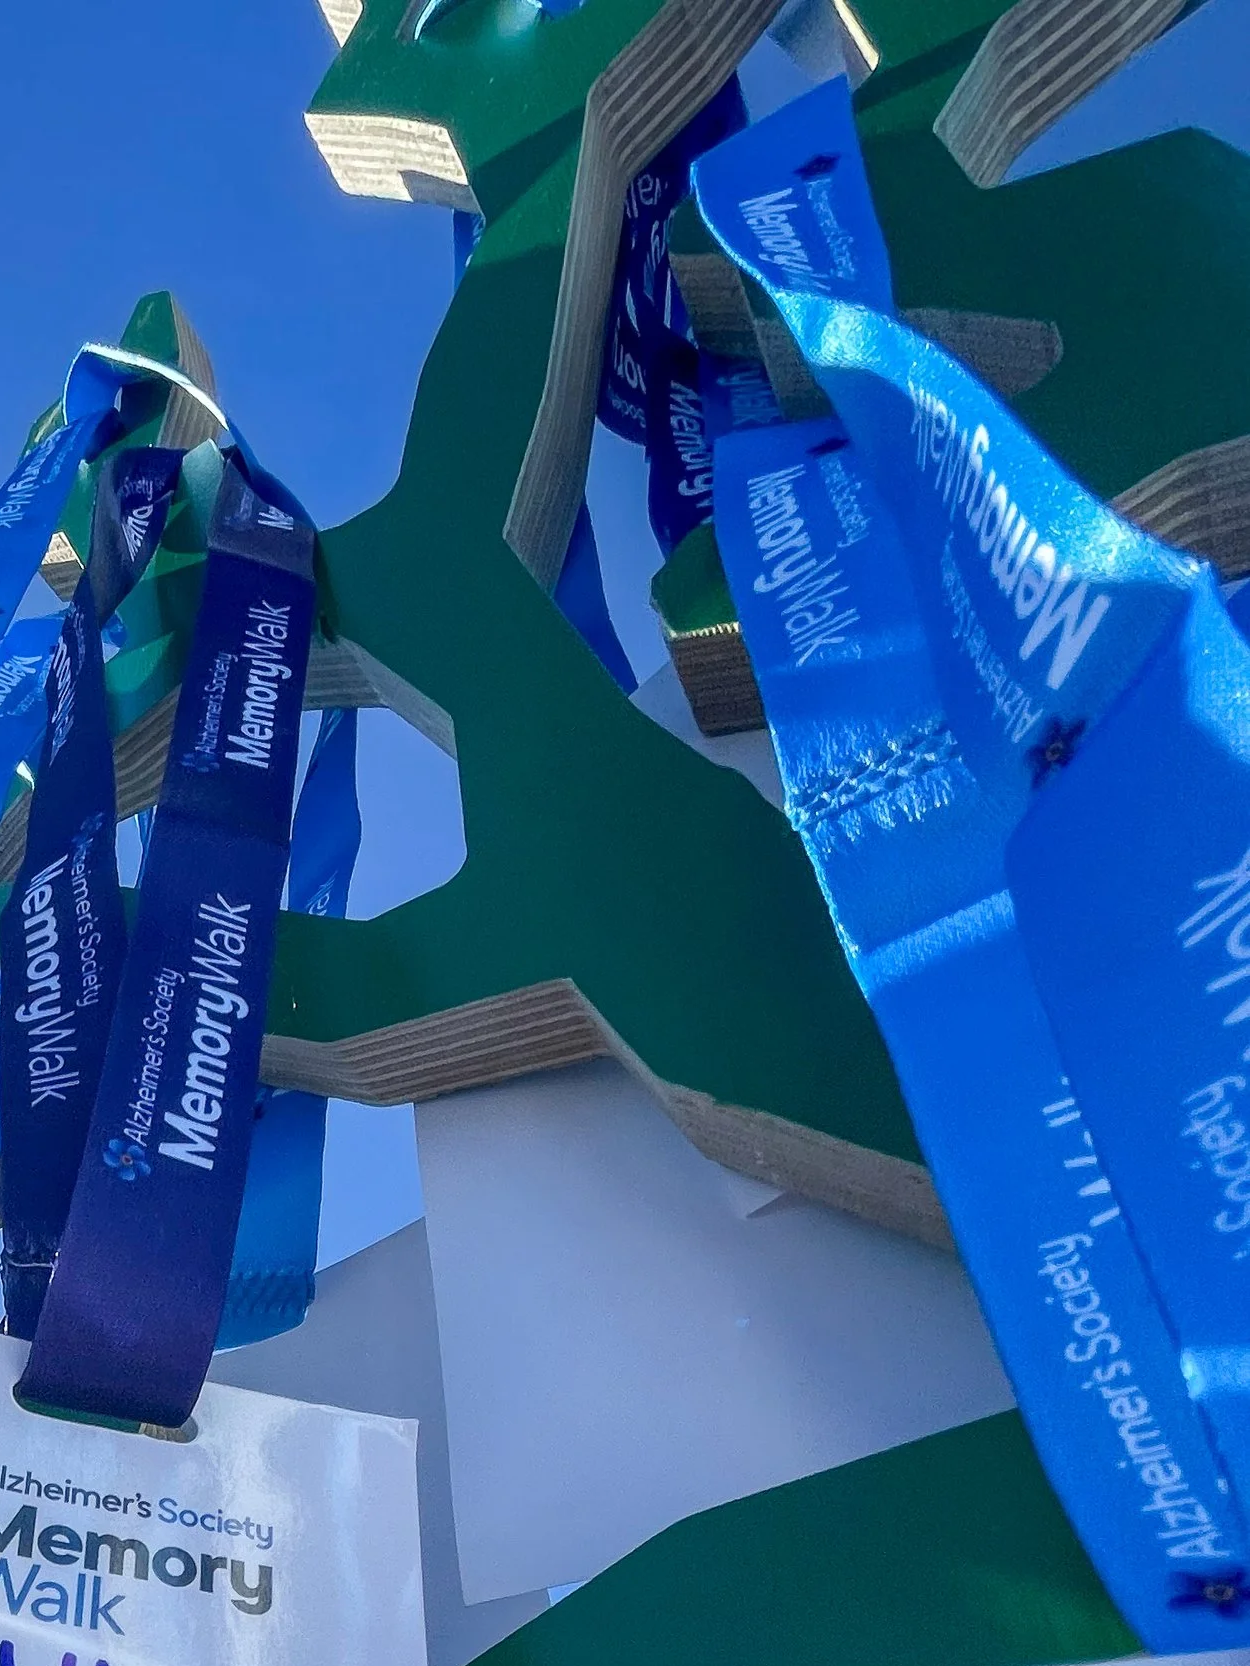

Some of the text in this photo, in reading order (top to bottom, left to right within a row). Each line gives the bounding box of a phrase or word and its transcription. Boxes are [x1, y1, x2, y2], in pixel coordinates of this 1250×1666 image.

[123, 968, 184, 1147] Alzheimer's Society
[159, 892, 251, 1171] MemoryWalk
[1038, 1233, 1122, 1362] Society
[158, 1498, 275, 1551] Society
[1081, 1360, 1230, 1557] Alzheimer's
